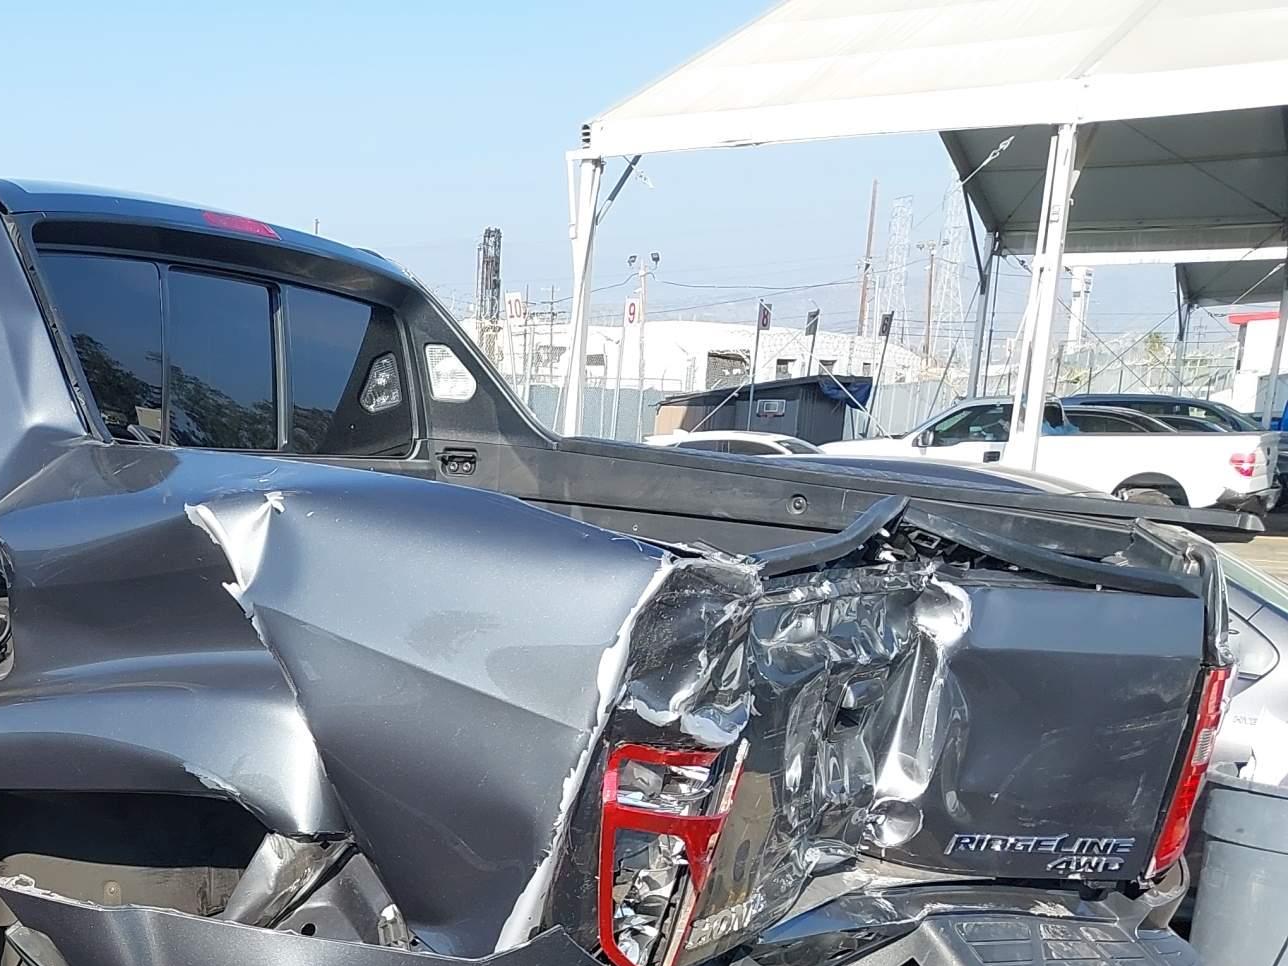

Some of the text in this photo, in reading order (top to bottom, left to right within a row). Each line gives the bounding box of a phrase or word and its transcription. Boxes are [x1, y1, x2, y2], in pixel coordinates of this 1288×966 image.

[508, 299, 522, 318] 10
[628, 302, 636, 323] 9
[880, 317, 889, 333] 6
[943, 833, 1136, 855] RIDGELINE
[1045, 855, 1126, 874] 4WD
